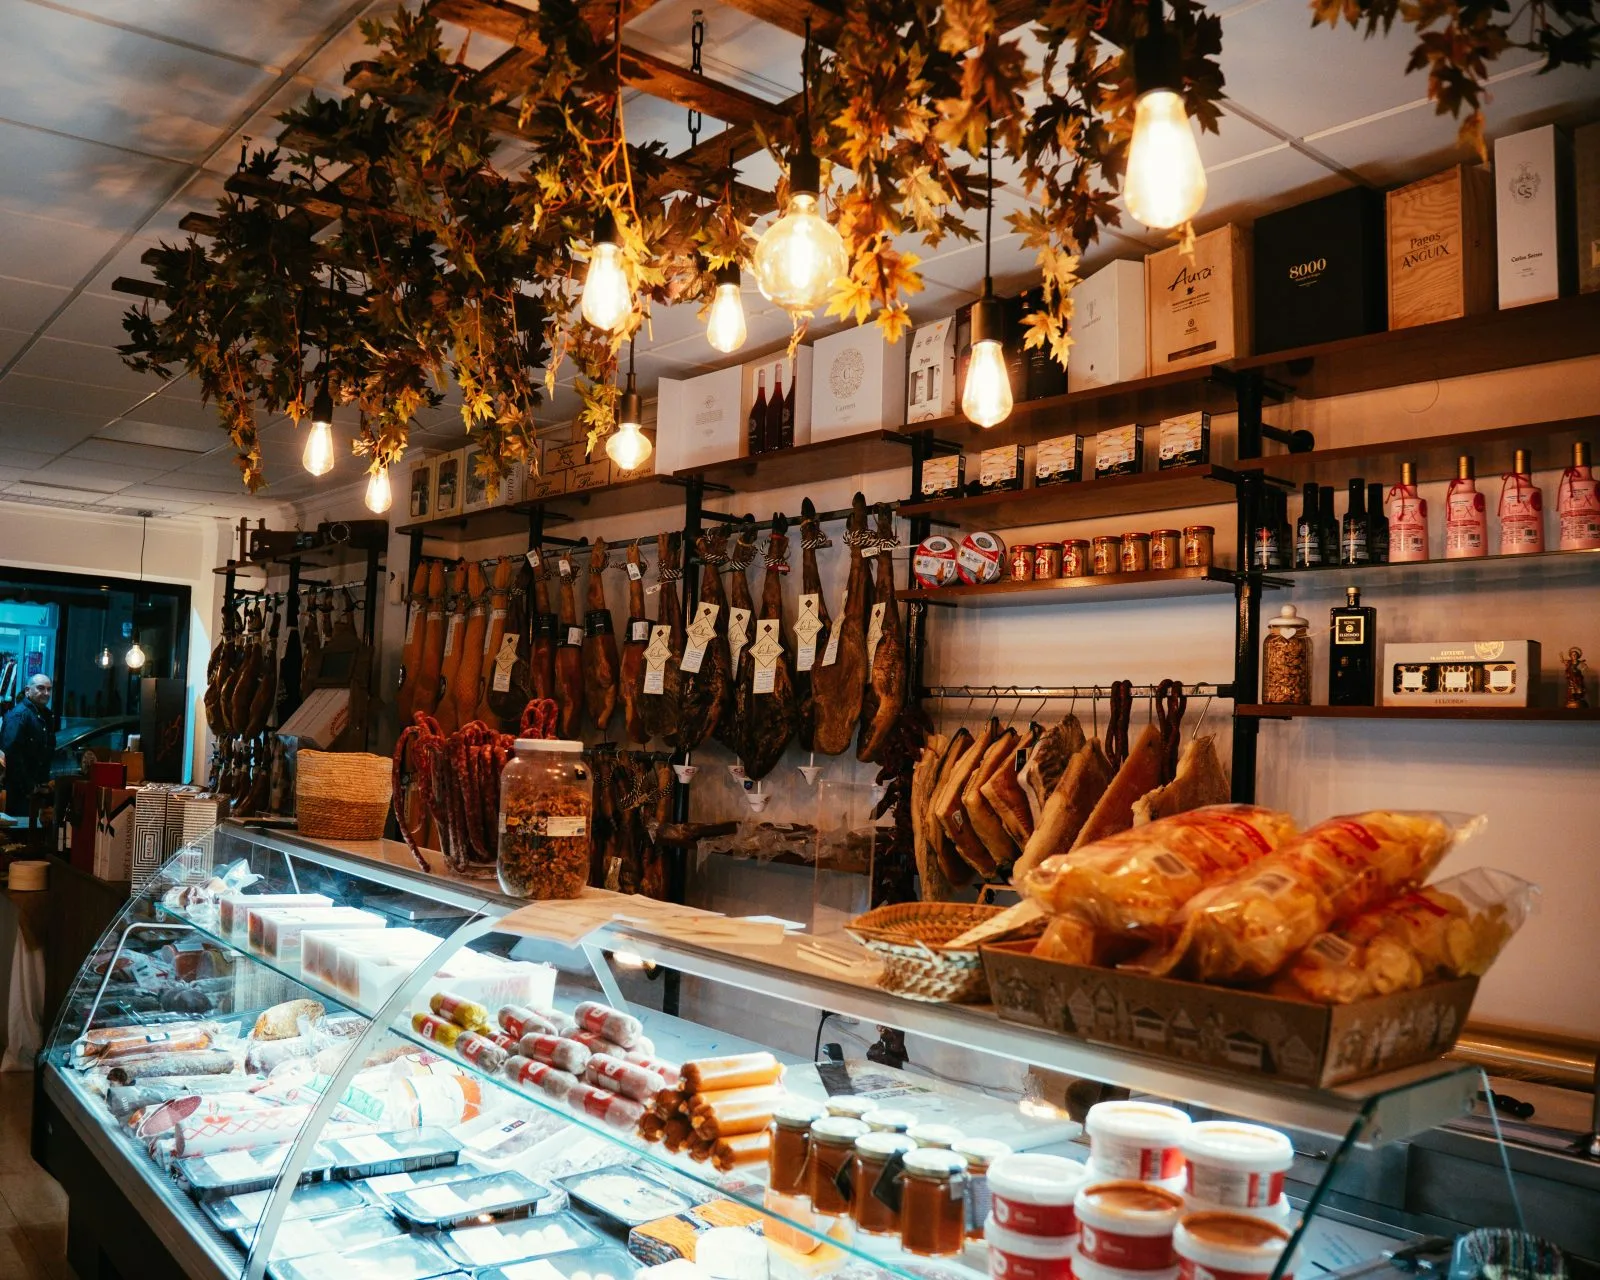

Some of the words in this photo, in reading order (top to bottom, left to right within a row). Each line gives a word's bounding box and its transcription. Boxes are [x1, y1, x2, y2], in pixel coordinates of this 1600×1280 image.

[1410, 232, 1441, 249] Pagos
[1401, 242, 1450, 270] ANGUIX
[1167, 267, 1212, 291] Aura
[1289, 258, 1327, 279] 8000
